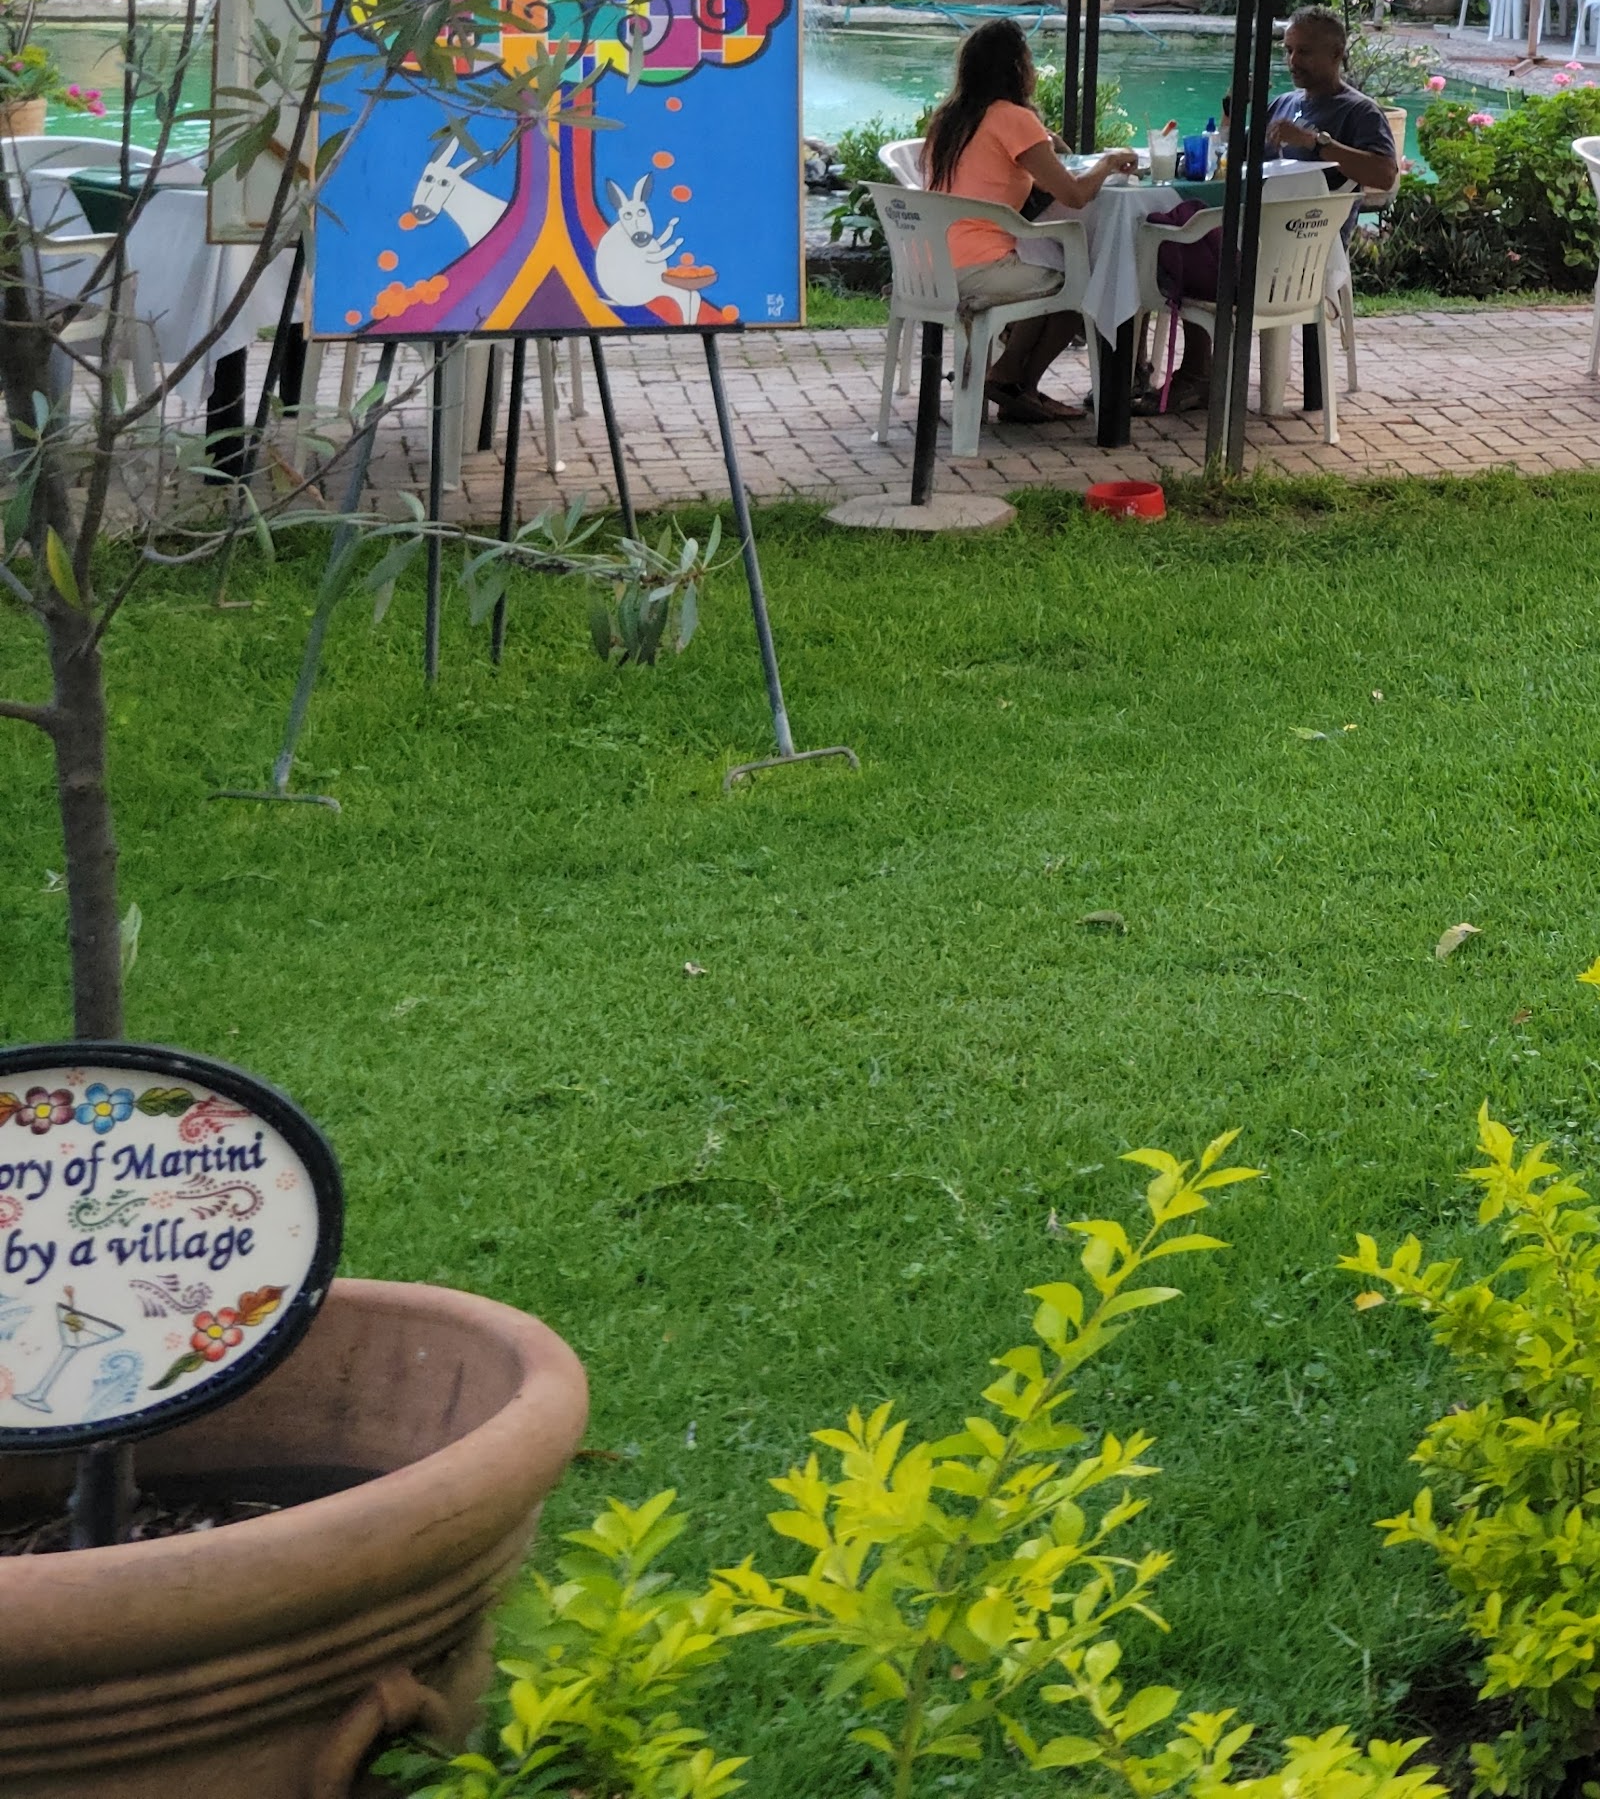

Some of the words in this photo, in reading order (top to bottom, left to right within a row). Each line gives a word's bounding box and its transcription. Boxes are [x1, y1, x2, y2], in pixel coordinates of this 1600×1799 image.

[1285, 218, 1329, 232] Corona
[1296, 230, 1319, 239] Extra
[0, 1159, 54, 1201] ory
[64, 1140, 107, 1196] of
[111, 1131, 268, 1182] Martini
[5, 1228, 57, 1285] by
[69, 1236, 98, 1267] a
[106, 1217, 256, 1272] village
